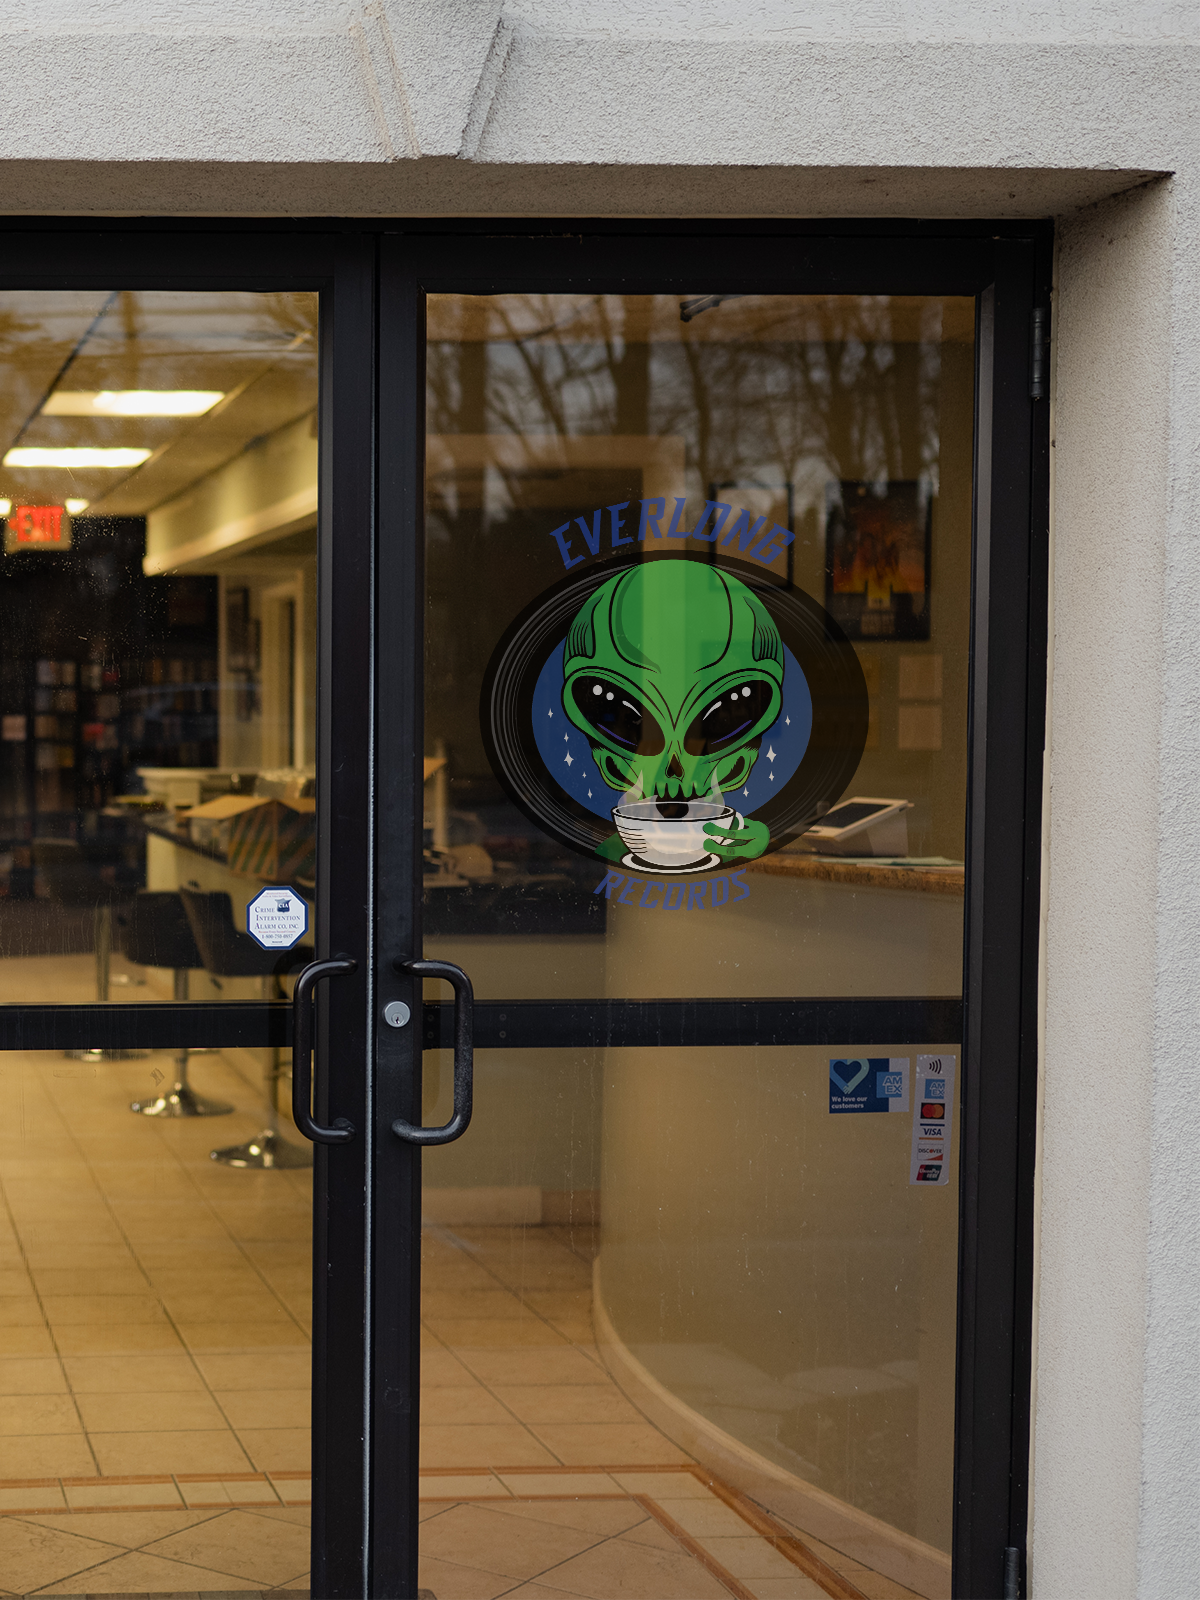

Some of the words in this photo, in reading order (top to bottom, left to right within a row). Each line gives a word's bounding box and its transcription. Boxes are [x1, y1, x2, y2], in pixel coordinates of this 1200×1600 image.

[16, 505, 64, 542] EXIT
[549, 496, 796, 571] EVERLONG
[592, 868, 751, 911] RECORDS
[923, 1128, 942, 1136] VISA
